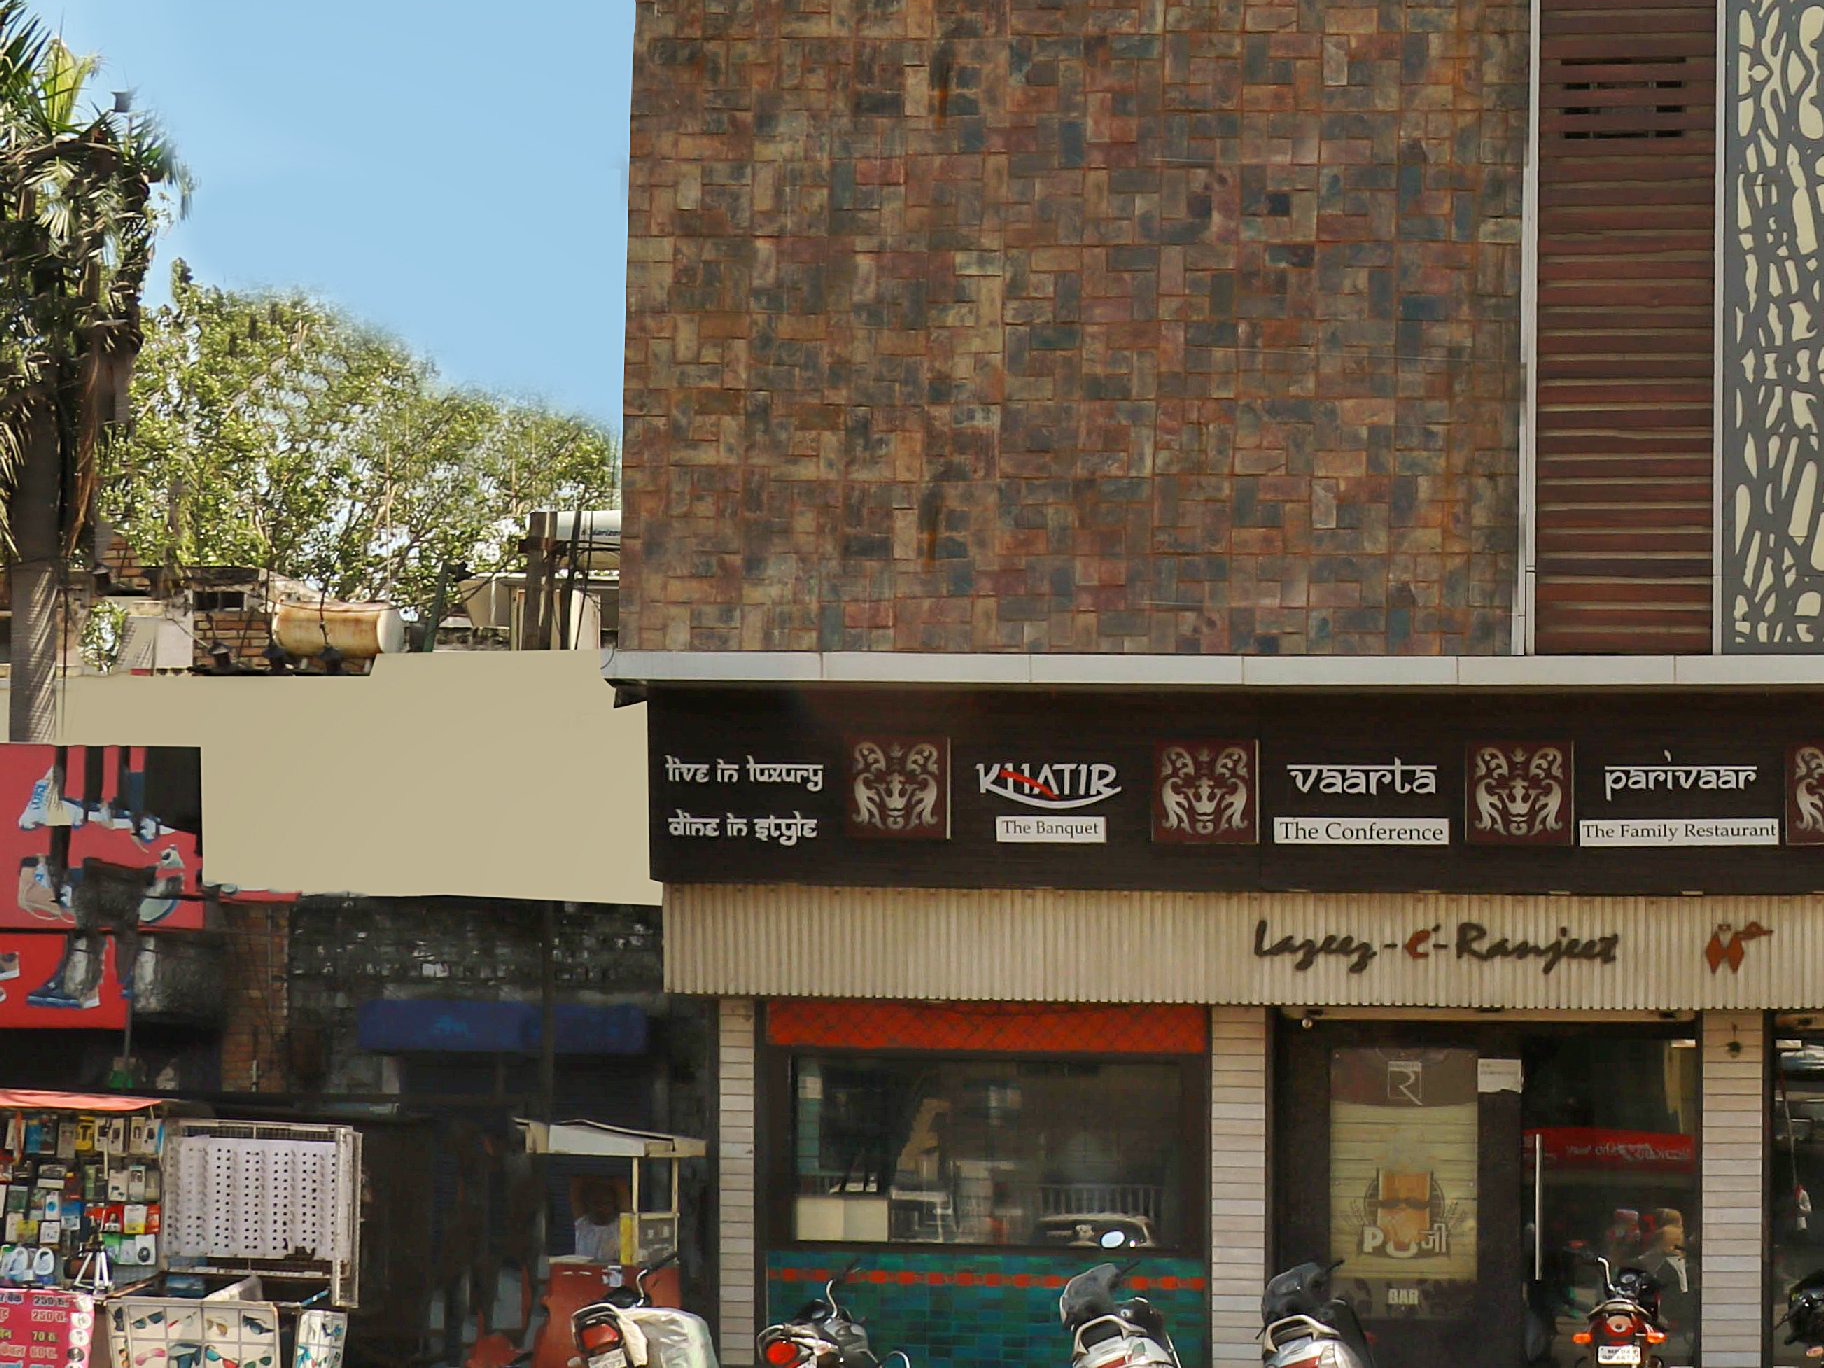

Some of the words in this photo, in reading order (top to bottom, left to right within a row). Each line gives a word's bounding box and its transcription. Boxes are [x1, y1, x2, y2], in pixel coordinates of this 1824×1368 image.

[665, 755, 710, 783] live
[716, 758, 739, 783] in
[746, 755, 824, 792] luxury
[975, 762, 1122, 809] KHATIR
[1287, 757, 1438, 795] vaarta
[1604, 750, 1758, 801] parivaar
[668, 809, 720, 837] dine
[726, 813, 748, 837] in
[753, 810, 818, 846] style
[1002, 820, 1031, 834] The
[1036, 820, 1099, 839] Banquet
[1279, 821, 1321, 841] The
[1325, 821, 1444, 842] Conference
[1582, 824, 1617, 839] The
[1620, 823, 1678, 842] Family
[1683, 822, 1777, 838] Restaurant
[1387, 1288, 1419, 1304] BAR
